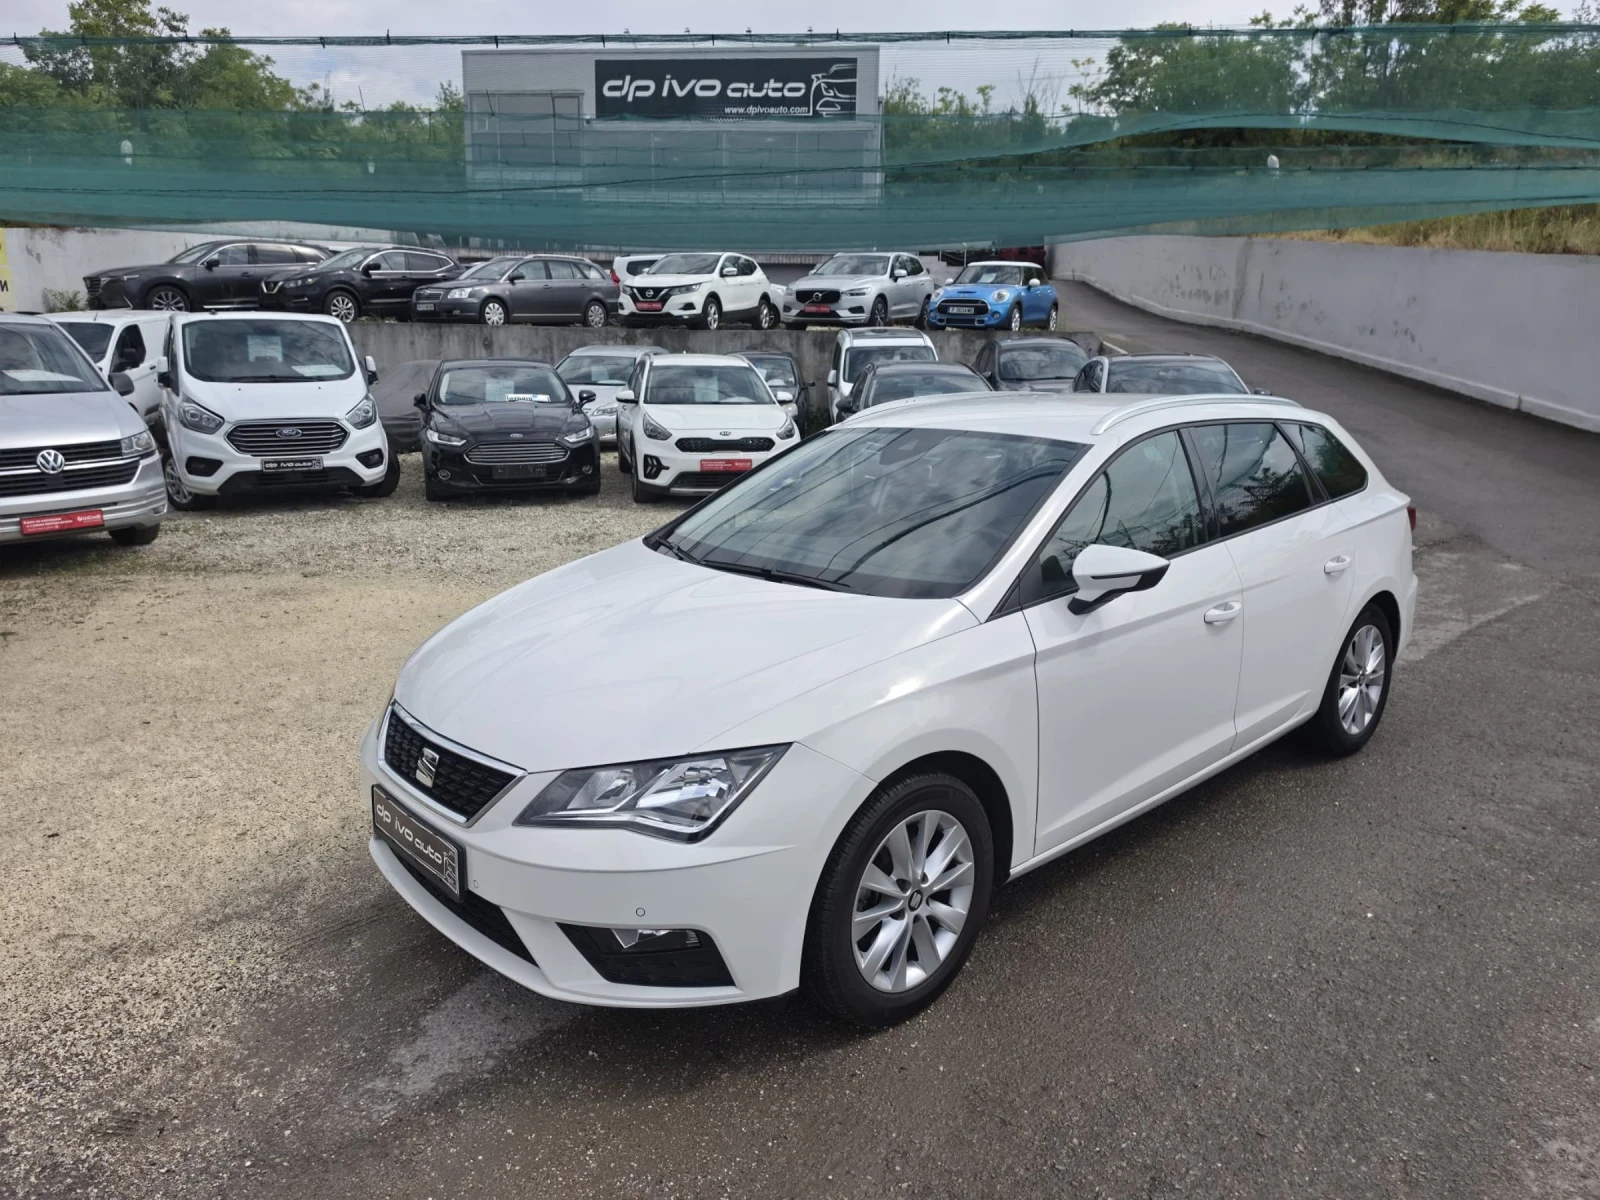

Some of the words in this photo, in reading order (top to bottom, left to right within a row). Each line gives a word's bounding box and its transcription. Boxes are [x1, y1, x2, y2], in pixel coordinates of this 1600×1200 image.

[602, 74, 656, 102] dp
[661, 74, 722, 98] ivo
[726, 78, 807, 98] auto
[376, 804, 392, 823] dp
[394, 816, 414, 842] ivo
[414, 838, 443, 864] auto
